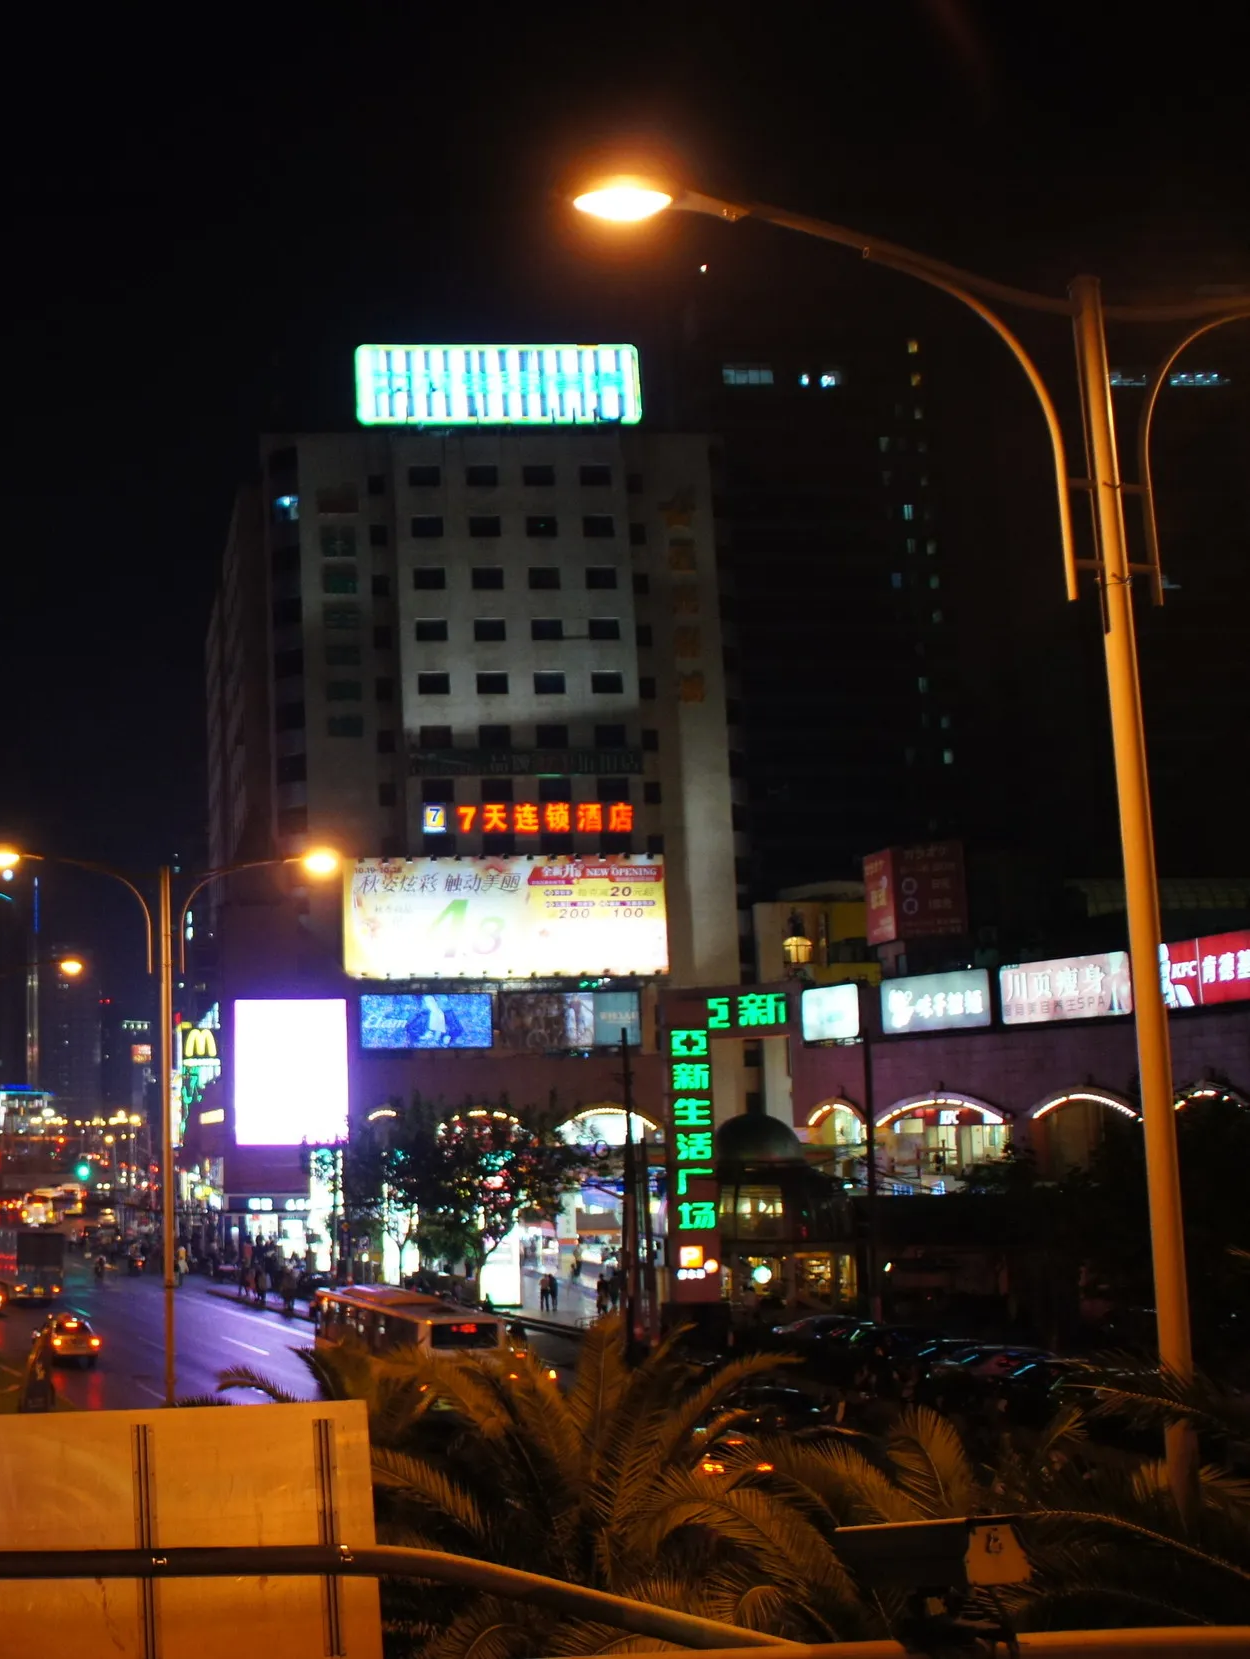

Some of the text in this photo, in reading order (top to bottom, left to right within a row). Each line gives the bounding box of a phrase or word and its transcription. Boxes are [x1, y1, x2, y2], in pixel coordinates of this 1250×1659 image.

[456, 802, 634, 833] 7天连锁酒店
[587, 867, 609, 876] NEW
[612, 867, 657, 876] OPENING
[445, 872, 522, 893] 触动美丽
[1171, 961, 1198, 979] KFC
[1008, 963, 1106, 1000] 川页瘦身
[681, 1248, 700, 1267] P
